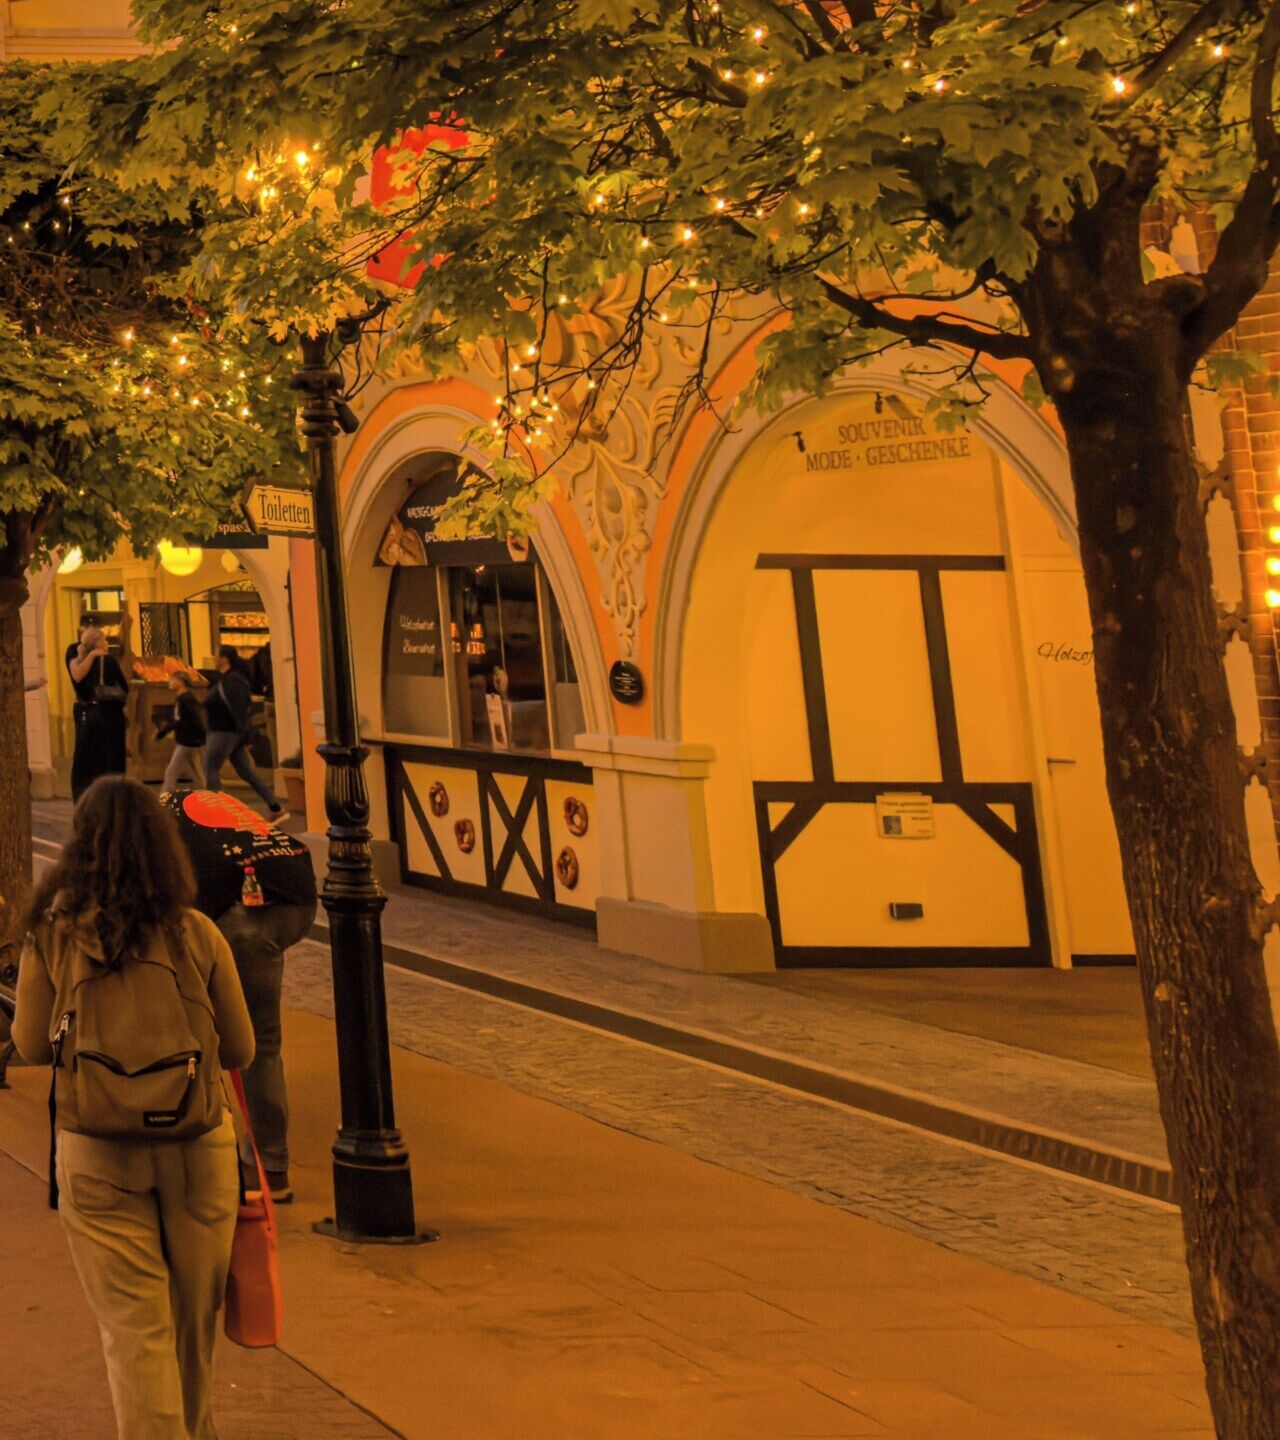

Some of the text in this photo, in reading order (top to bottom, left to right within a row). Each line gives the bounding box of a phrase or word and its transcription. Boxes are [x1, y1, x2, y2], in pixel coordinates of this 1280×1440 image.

[838, 416, 927, 445] SOUVENIR
[806, 437, 971, 472] MODE GESCHENKE
[258, 493, 311, 524] Toiletten
